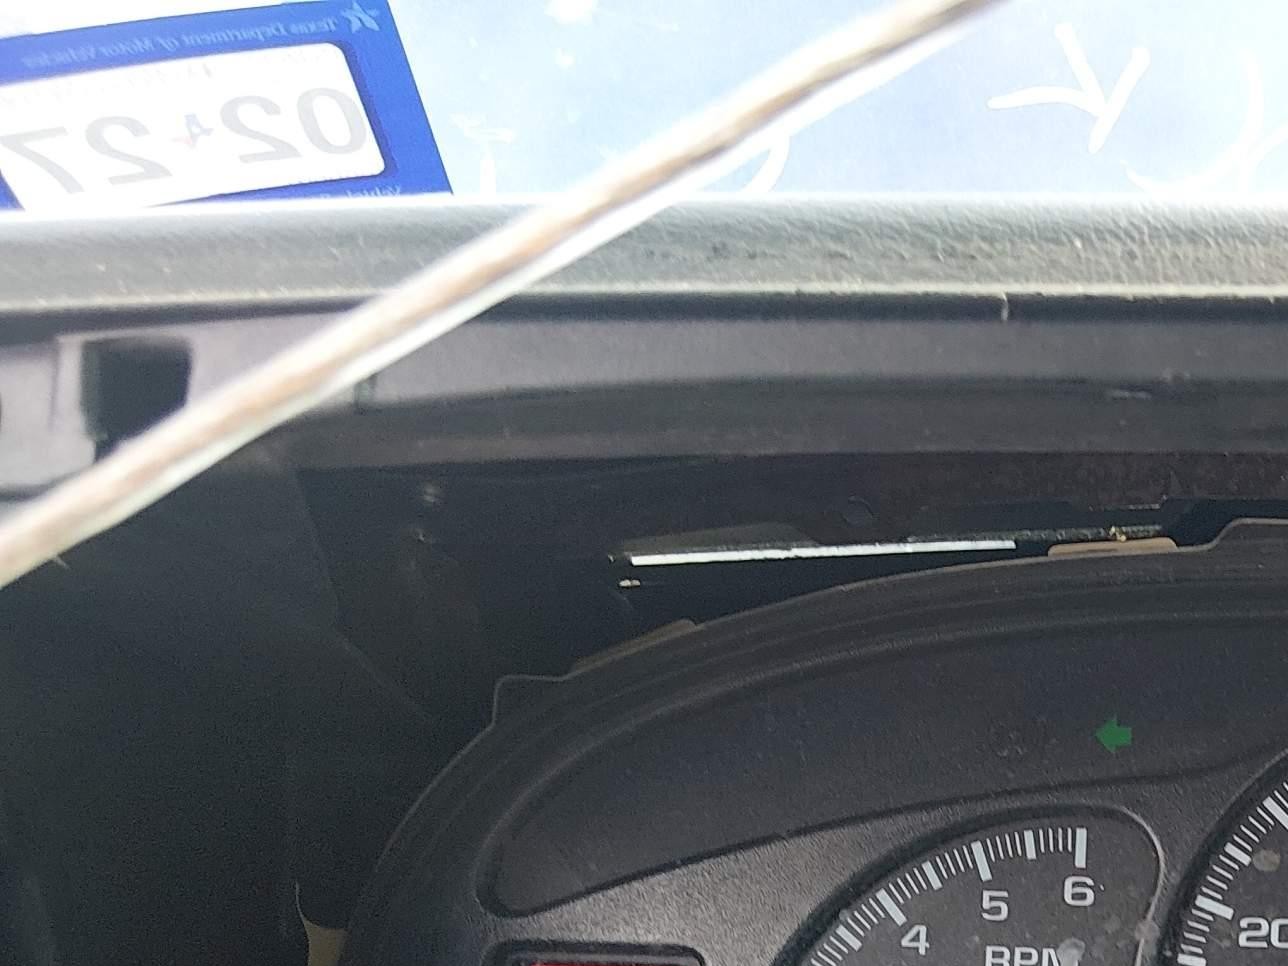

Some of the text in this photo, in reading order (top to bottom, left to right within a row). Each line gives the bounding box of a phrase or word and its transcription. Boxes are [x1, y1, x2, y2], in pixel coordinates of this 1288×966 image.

[982, 889, 1010, 922] 5
[1064, 875, 1095, 907] 6
[901, 924, 930, 955] 4
